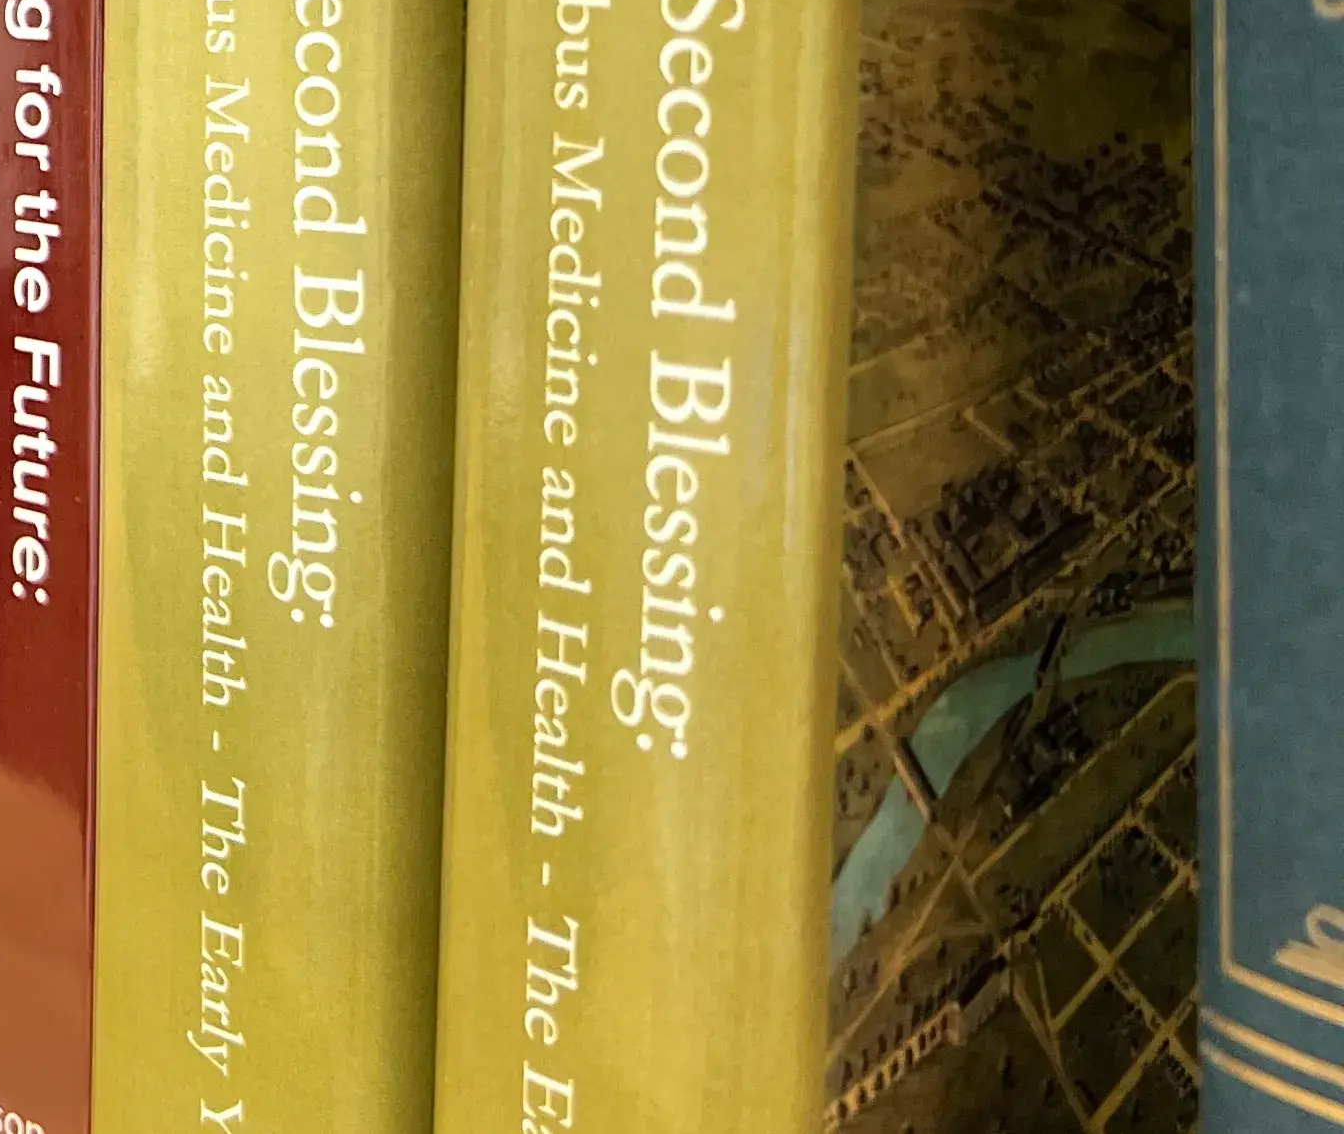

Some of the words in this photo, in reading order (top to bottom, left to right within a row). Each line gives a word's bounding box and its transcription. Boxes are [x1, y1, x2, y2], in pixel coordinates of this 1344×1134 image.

[13, 64, 63, 170] for
[13, 191, 63, 315] the
[202, 75, 253, 357] Medicine
[543, 133, 606, 448] Medicine
[12, 336, 61, 606] Future:
[201, 374, 250, 488] and
[267, 266, 367, 628] Blessing:
[200, 502, 248, 710] Health
[538, 466, 591, 595] and
[609, 348, 733, 761] Blessing:
[530, 610, 589, 839] Health
[199, 776, 246, 896] The
[186, 910, 246, 1077] Early
[524, 914, 580, 1047] The
